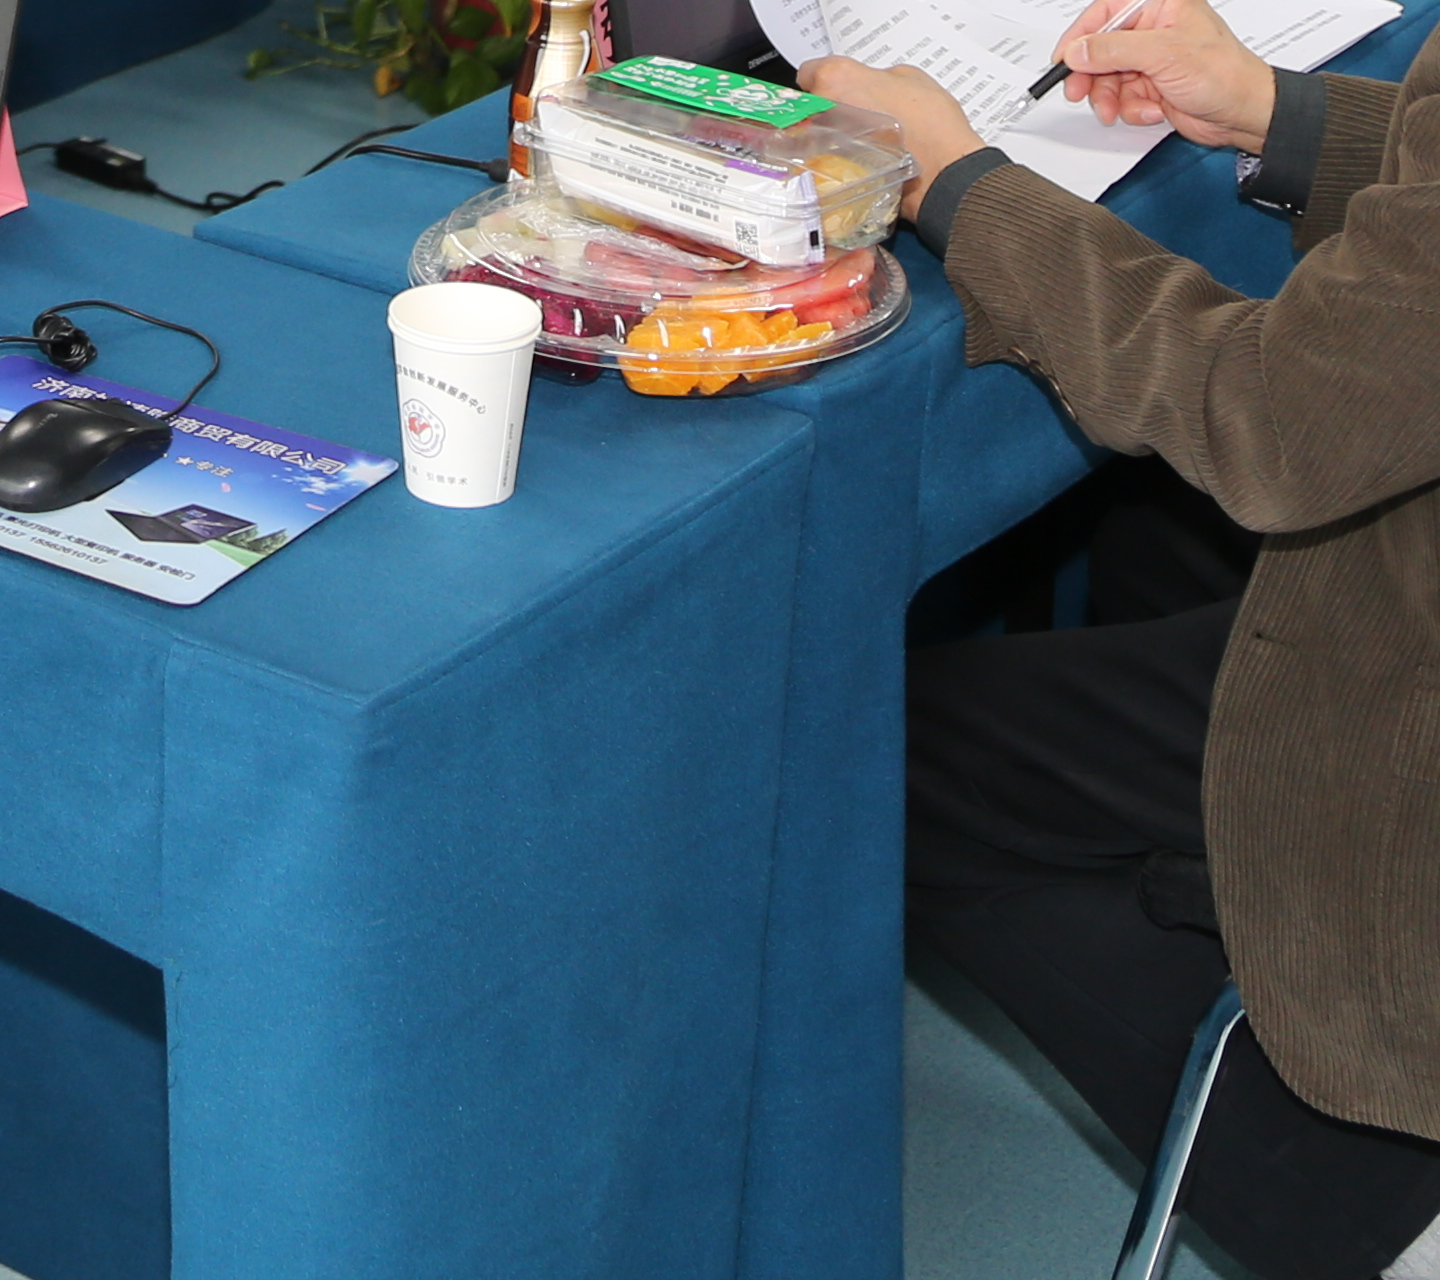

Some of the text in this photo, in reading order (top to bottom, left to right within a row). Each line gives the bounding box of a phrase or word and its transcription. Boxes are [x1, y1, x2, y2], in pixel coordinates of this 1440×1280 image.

[31, 376, 347, 475] 济南商贸有限公司
